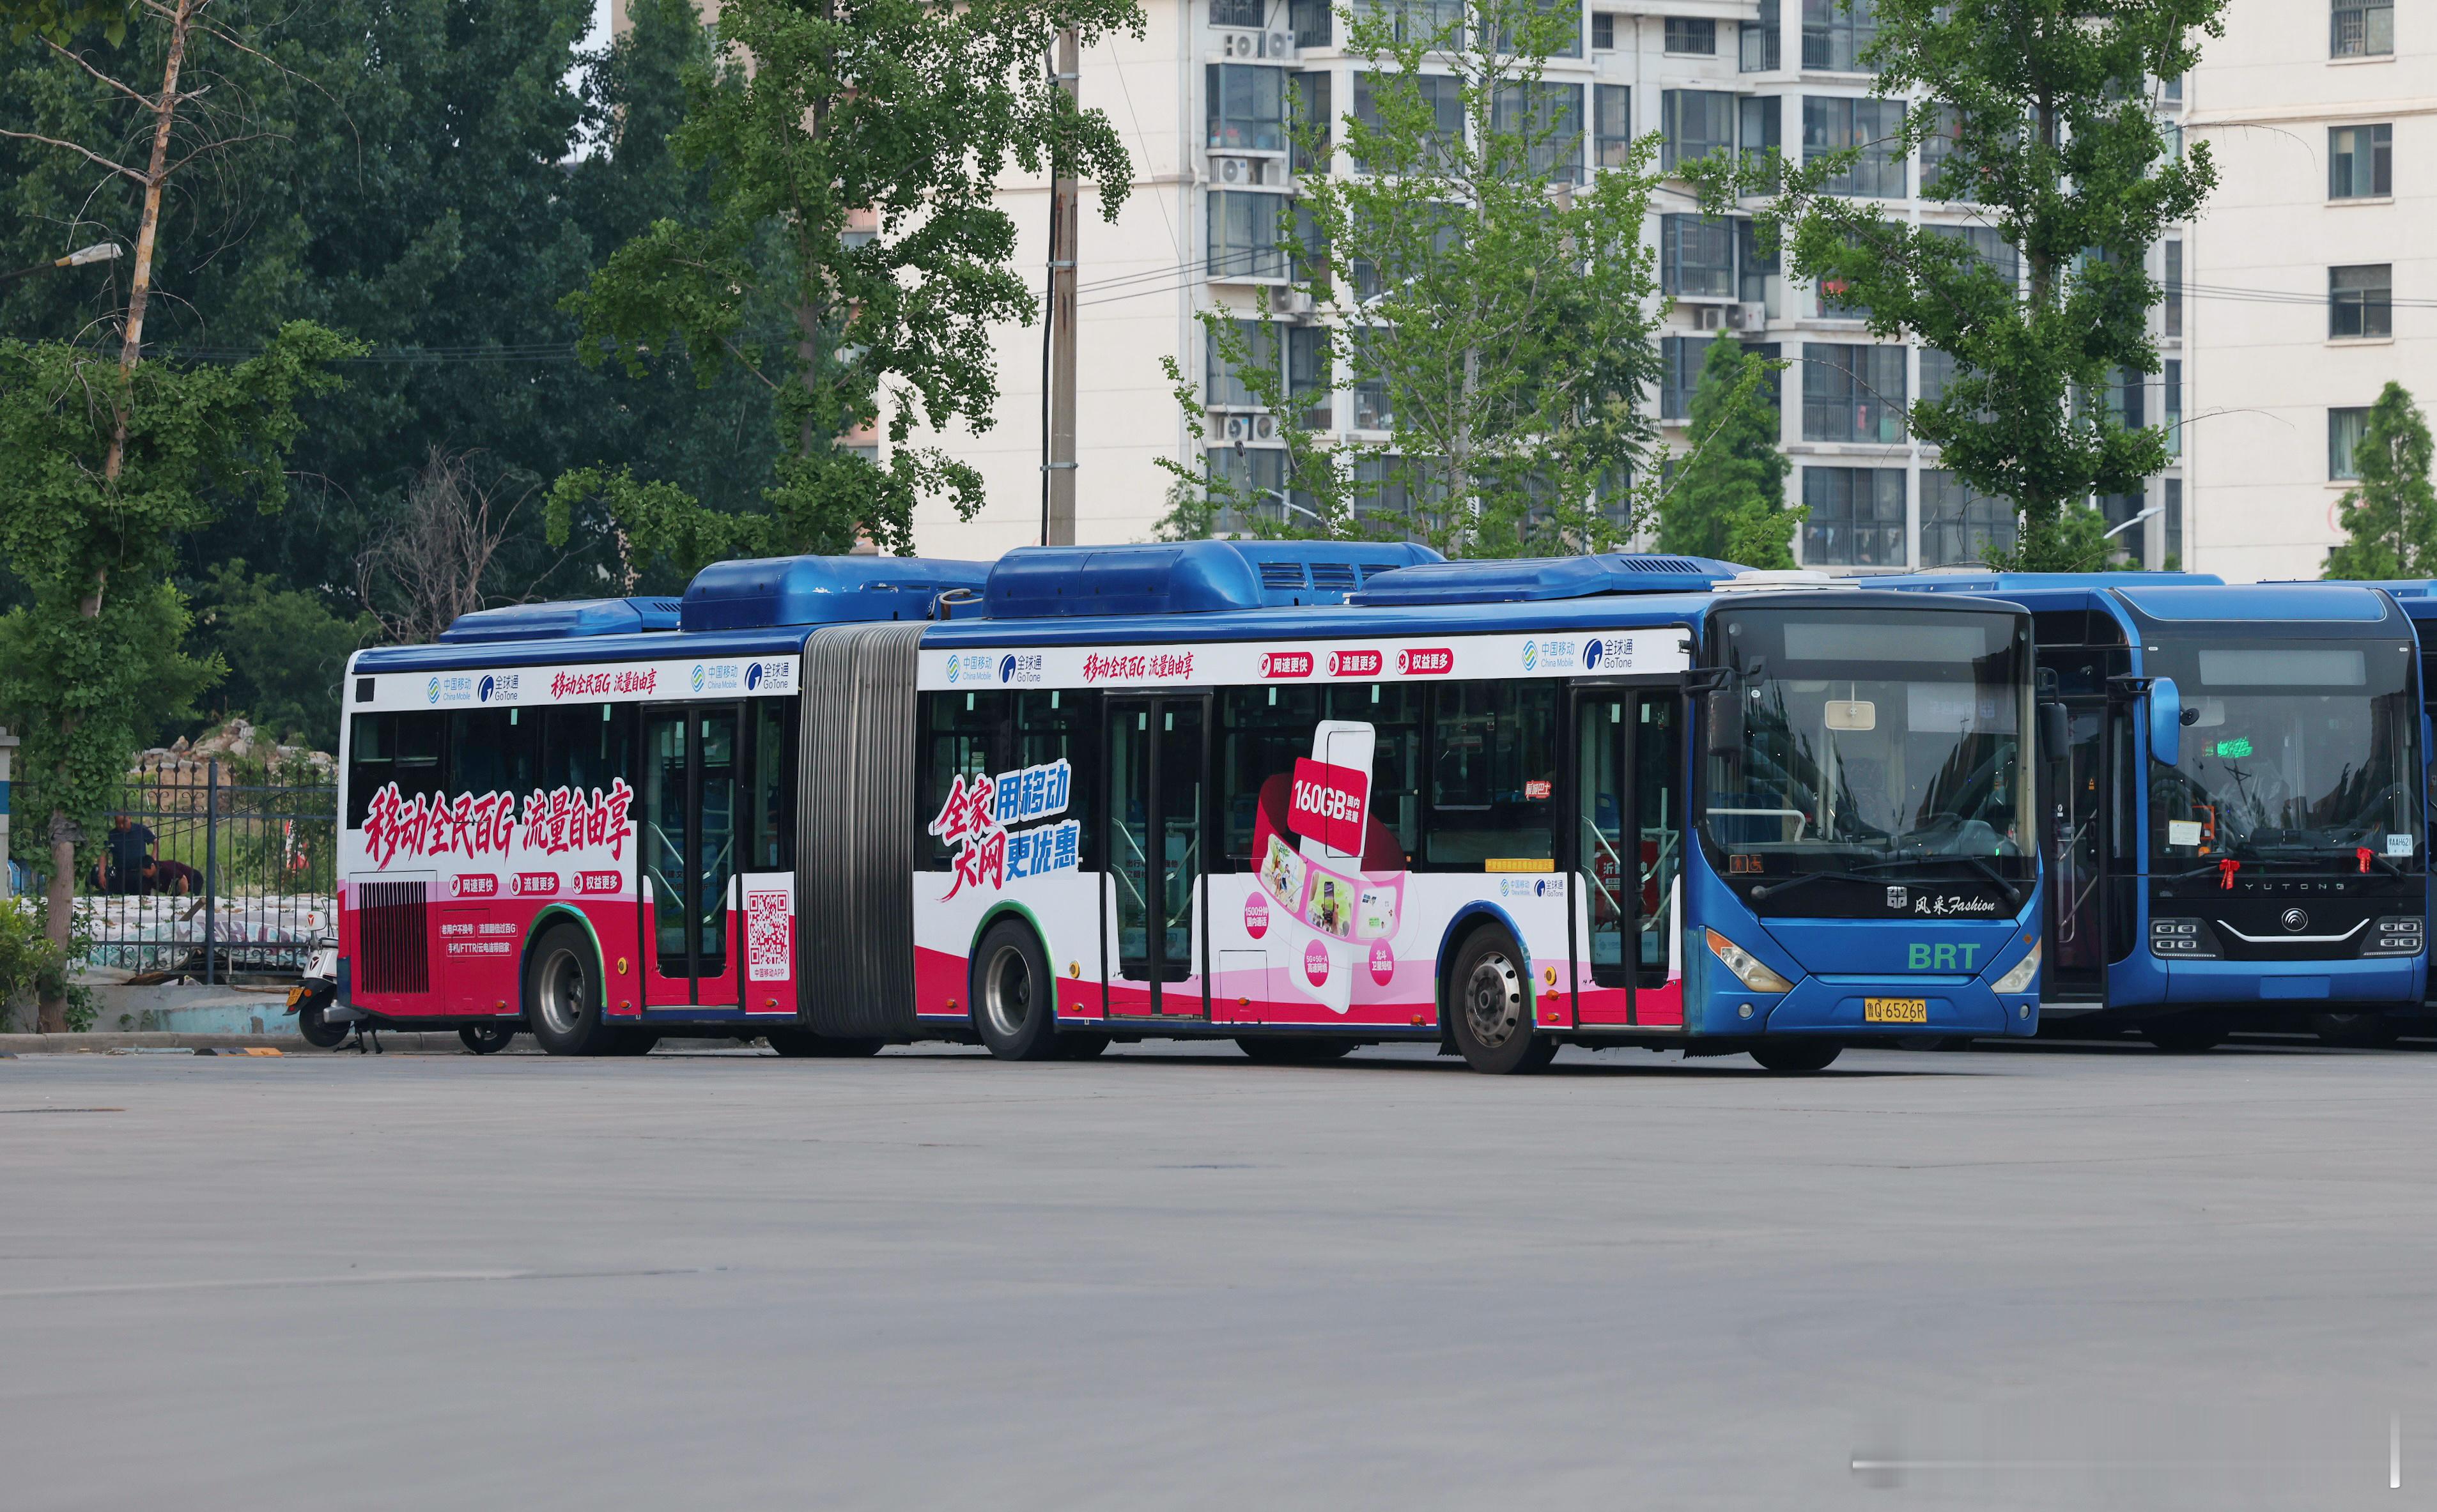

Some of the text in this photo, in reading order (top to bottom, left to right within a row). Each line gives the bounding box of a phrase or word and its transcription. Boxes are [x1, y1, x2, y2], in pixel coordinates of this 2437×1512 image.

[1542, 641, 1575, 656] 中国移动
[1605, 639, 1632, 655] 全球通
[963, 656, 992, 670] 中国移动
[1017, 655, 1042, 670] 全球通
[1083, 652, 1194, 684] 移动全民百G 流量自由享
[1273, 656, 1308, 673] 网速更快
[1342, 655, 1377, 672] 流量更多
[1412, 653, 1448, 670] 权益更多
[1541, 658, 1574, 668] China Mobile
[1604, 657, 1632, 668] GoTone
[708, 665, 738, 679] 中国移动
[764, 663, 789, 677] 全球通
[963, 671, 992, 681] China Mobile
[444, 677, 471, 691] 中国移动
[495, 675, 518, 690] 全球通
[551, 668, 657, 700] 移动全民百G 流量自由享
[764, 679, 788, 690] GoTone
[1017, 672, 1041, 683] GoTone
[708, 680, 737, 690] China Mobile
[495, 693, 518, 701] GoTone
[1295, 780, 1347, 820] 160GB
[1347, 795, 1360, 809] 国内
[1345, 809, 1359, 823] 流量
[364, 782, 631, 872] 移动全民百G 流量自由享
[463, 879, 493, 893] 网速更快
[524, 877, 555, 891] 流量更多
[586, 875, 617, 890] 权益更多
[1510, 880, 1529, 888] 中国移动
[1547, 880, 1563, 890] 全球通
[1246, 906, 1268, 916] 1500分钟
[1915, 895, 1995, 915] 风采 Fashion
[1247, 916, 1267, 927] 国内通话
[442, 924, 473, 934] 老用户不换号
[1376, 950, 1386, 960] 北斗
[1908, 943, 1981, 969] BRT
[754, 968, 785, 977] 中国移动APP
[1307, 963, 1327, 973] 高速网络
[1372, 961, 1393, 971] 卫星短信
